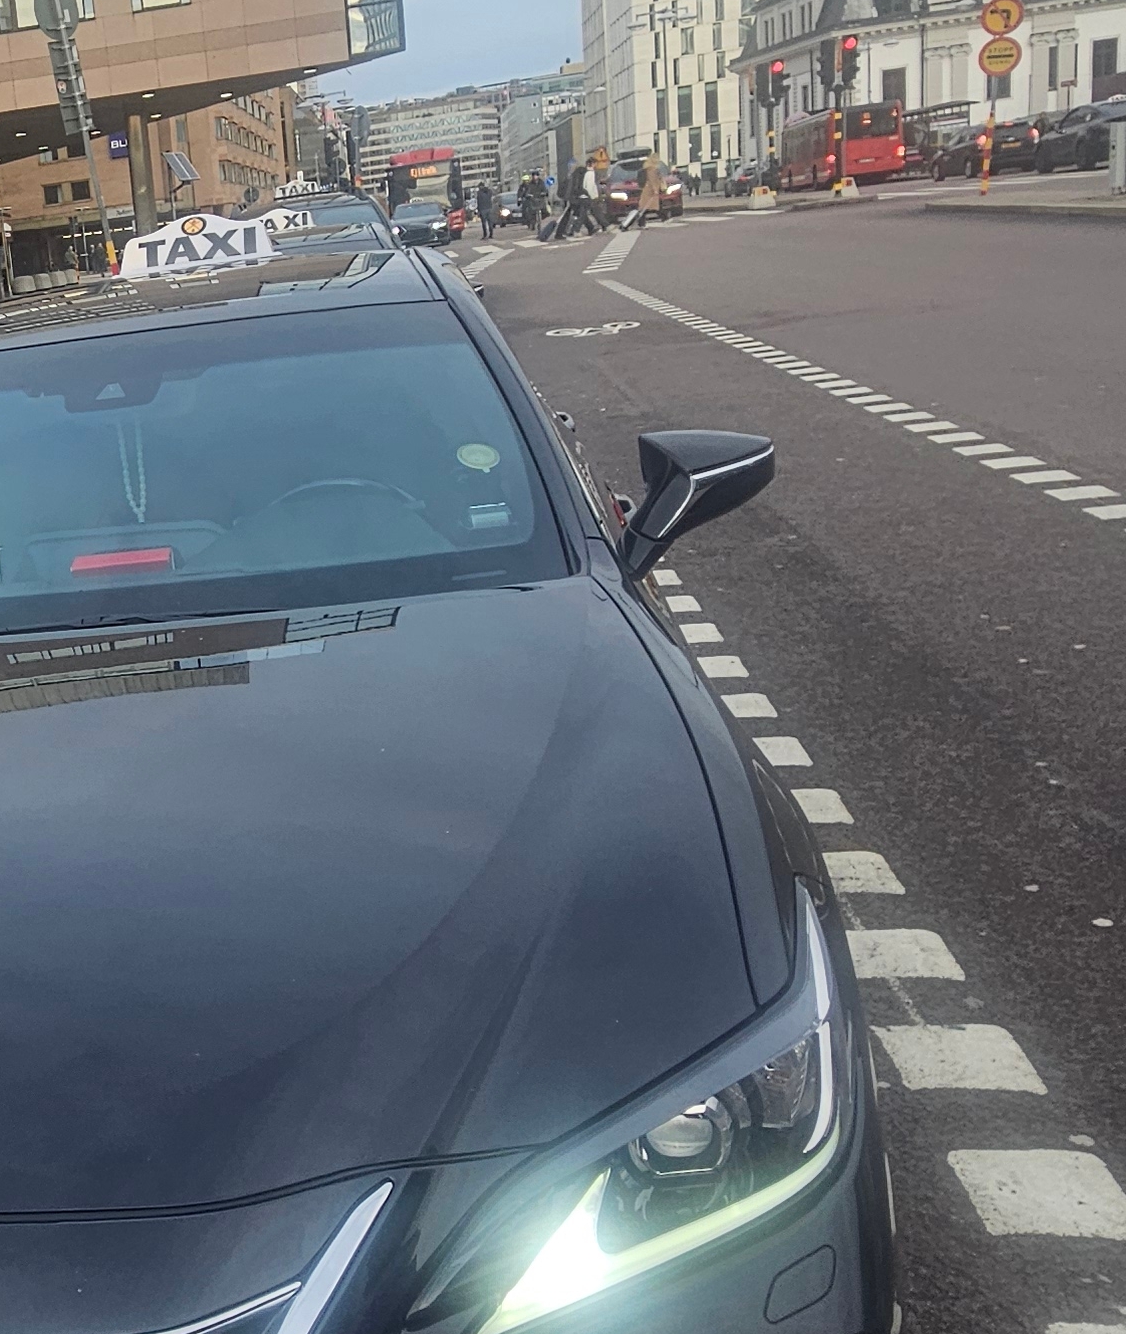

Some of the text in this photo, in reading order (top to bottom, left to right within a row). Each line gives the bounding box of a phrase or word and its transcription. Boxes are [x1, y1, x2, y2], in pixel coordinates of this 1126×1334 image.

[988, 46, 1014, 54] STOPP
[279, 182, 315, 197] TAXI
[261, 212, 308, 232] AXI
[138, 226, 258, 268] TAXI
